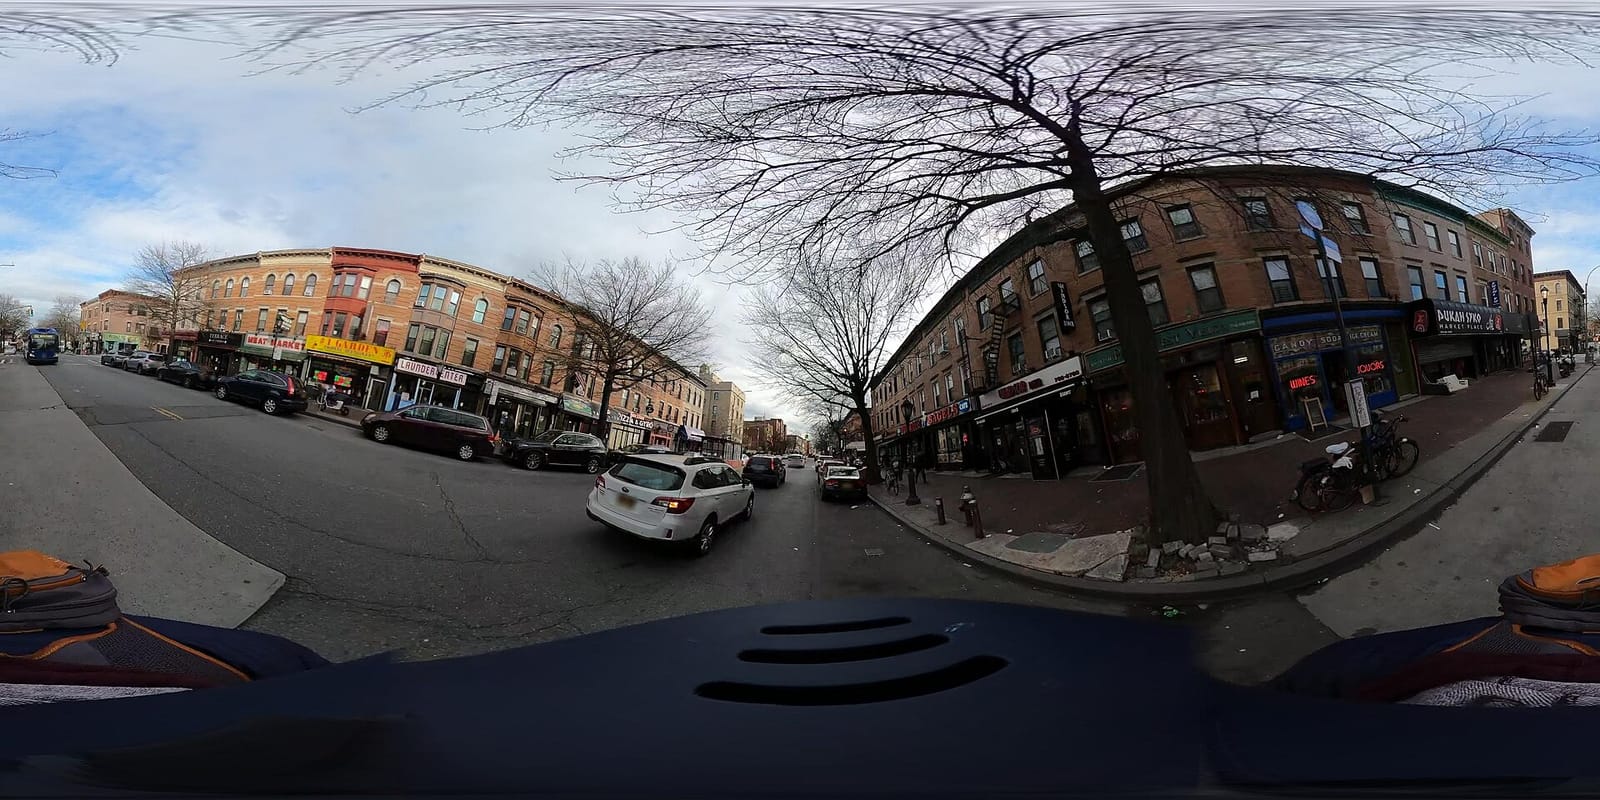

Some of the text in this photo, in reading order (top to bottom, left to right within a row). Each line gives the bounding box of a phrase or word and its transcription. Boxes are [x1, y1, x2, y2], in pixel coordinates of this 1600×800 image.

[247, 336, 268, 345] MEAT
[1274, 339, 1313, 351] CANDY
[1360, 331, 1378, 339] CREAM
[401, 360, 435, 376] LAUNDER
[1290, 376, 1316, 389] WINES
